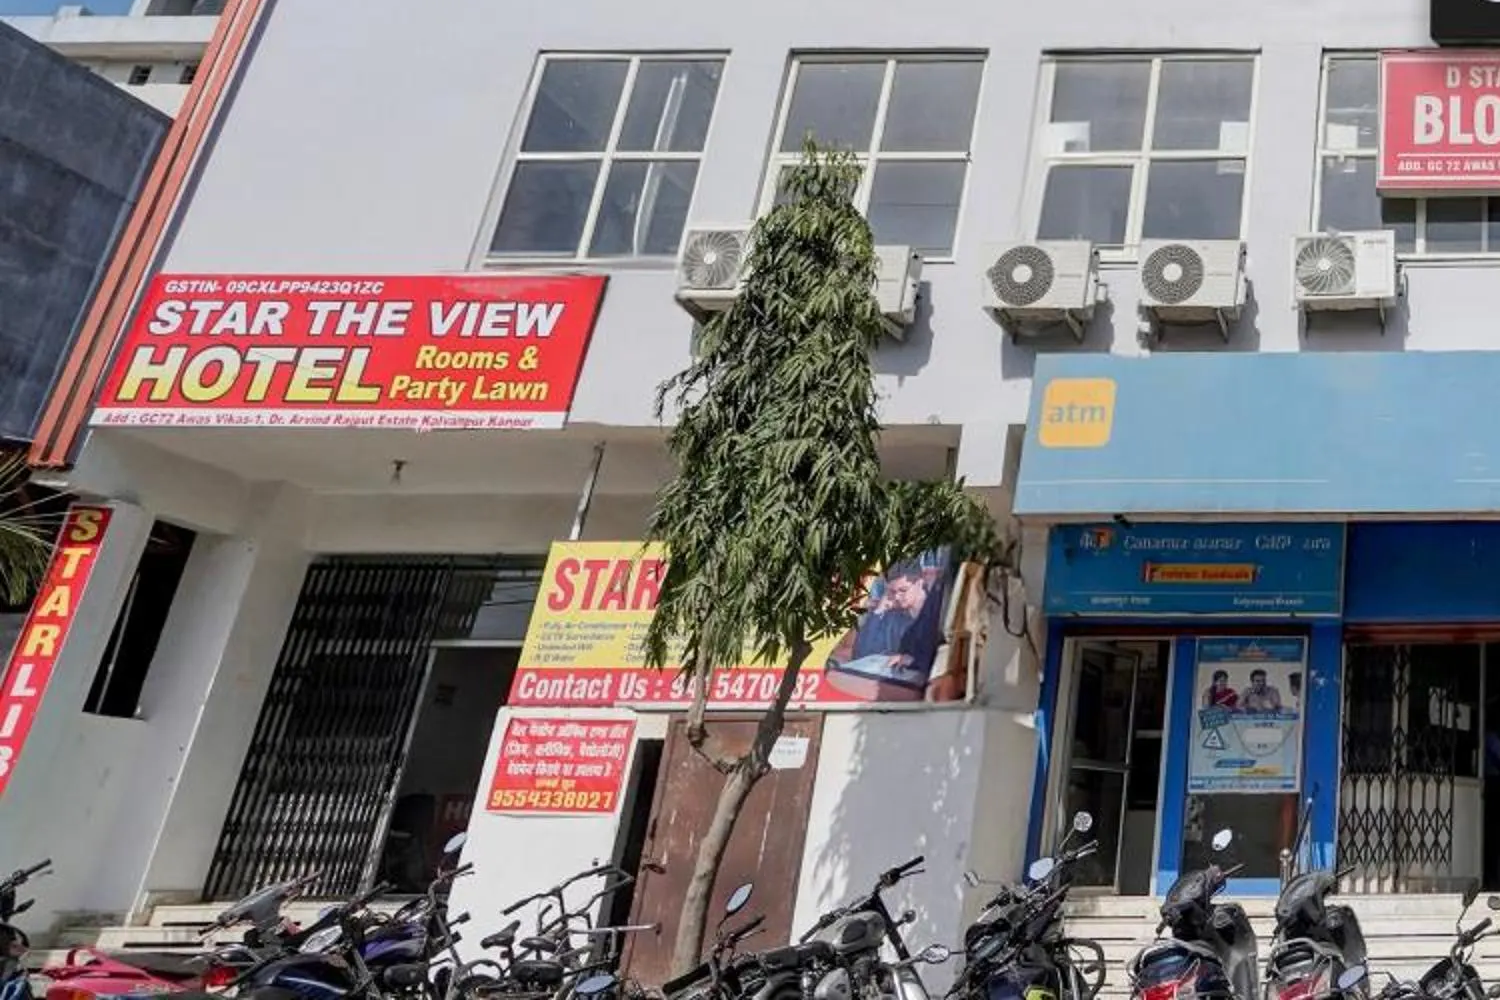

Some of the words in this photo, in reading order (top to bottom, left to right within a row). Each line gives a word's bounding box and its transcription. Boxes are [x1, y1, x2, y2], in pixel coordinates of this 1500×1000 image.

[1446, 67, 1461, 88] D
[150, 300, 290, 336] STAR
[305, 300, 413, 337] THE
[430, 301, 565, 337] VIEW
[415, 345, 510, 370] Rooms
[517, 345, 539, 370] &
[114, 344, 382, 403] HOTEL
[389, 375, 466, 405] Party
[472, 376, 548, 400] Lawn
[1048, 400, 1106, 424] atm
[547, 557, 666, 612] STAR
[518, 673, 613, 700] Contact
[618, 673, 647, 700] Us
[491, 789, 614, 809] 9554338027
